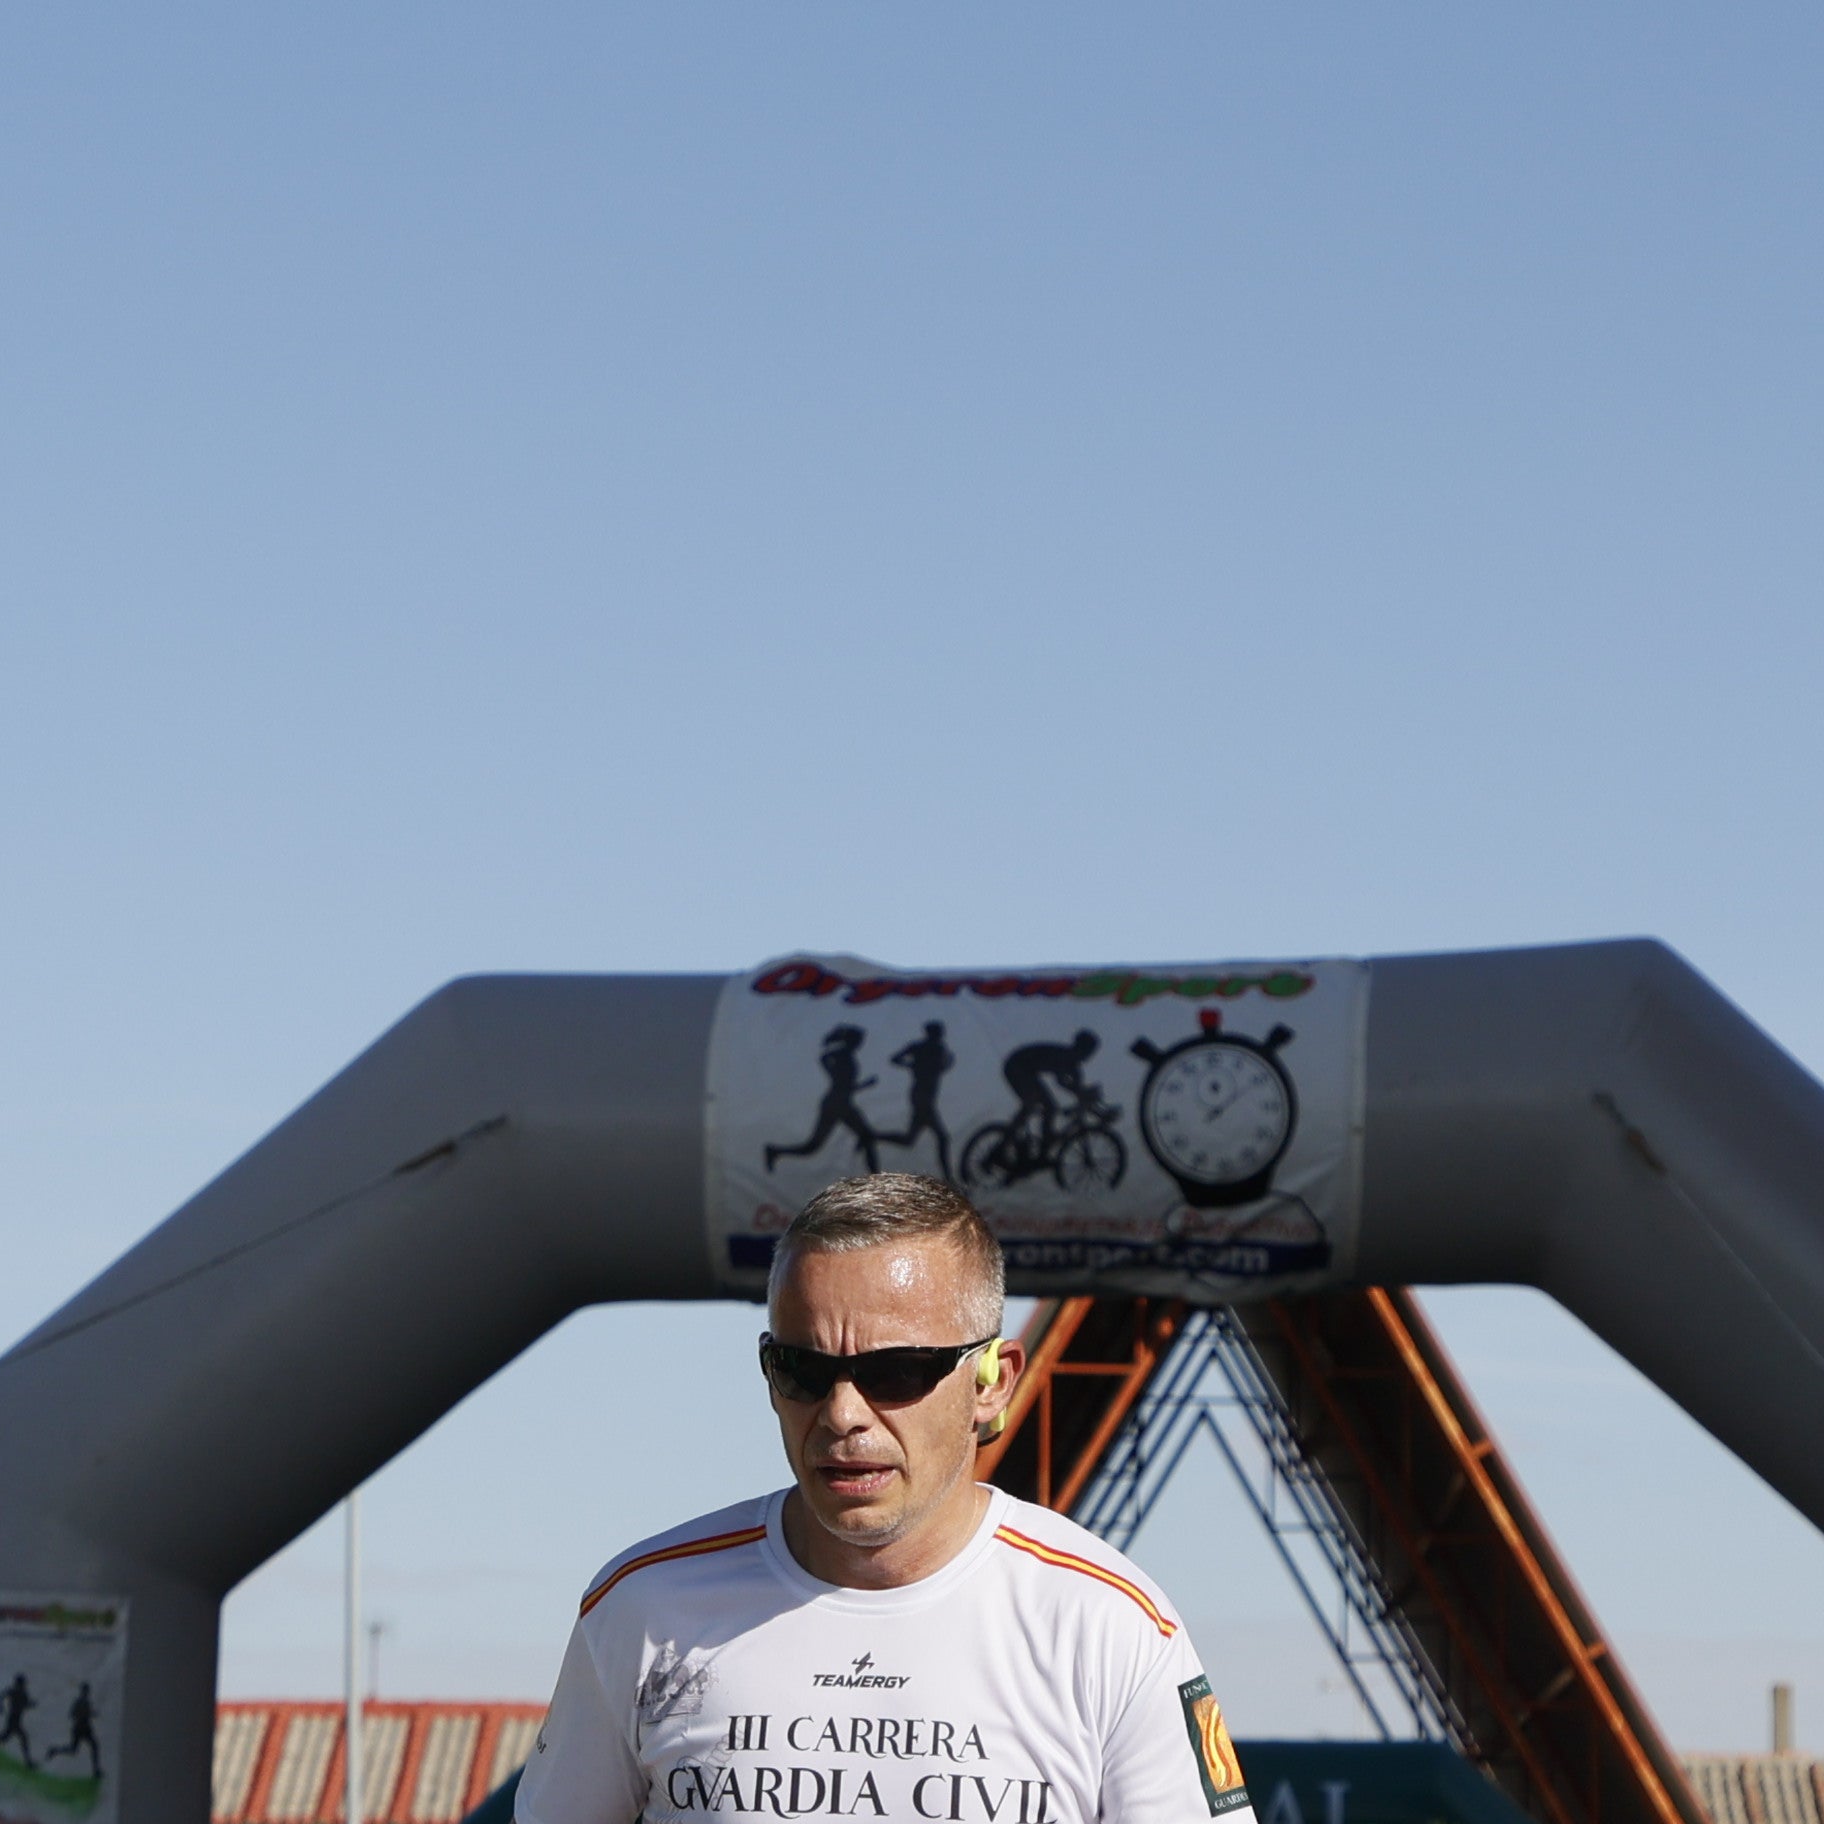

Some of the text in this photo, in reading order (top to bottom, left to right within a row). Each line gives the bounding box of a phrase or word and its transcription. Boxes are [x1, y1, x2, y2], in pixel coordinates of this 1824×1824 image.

[812, 1674, 912, 1690] TEAMERGY
[727, 1714, 991, 1764] III CARRERA
[667, 1766, 890, 1821] GVARDIA
